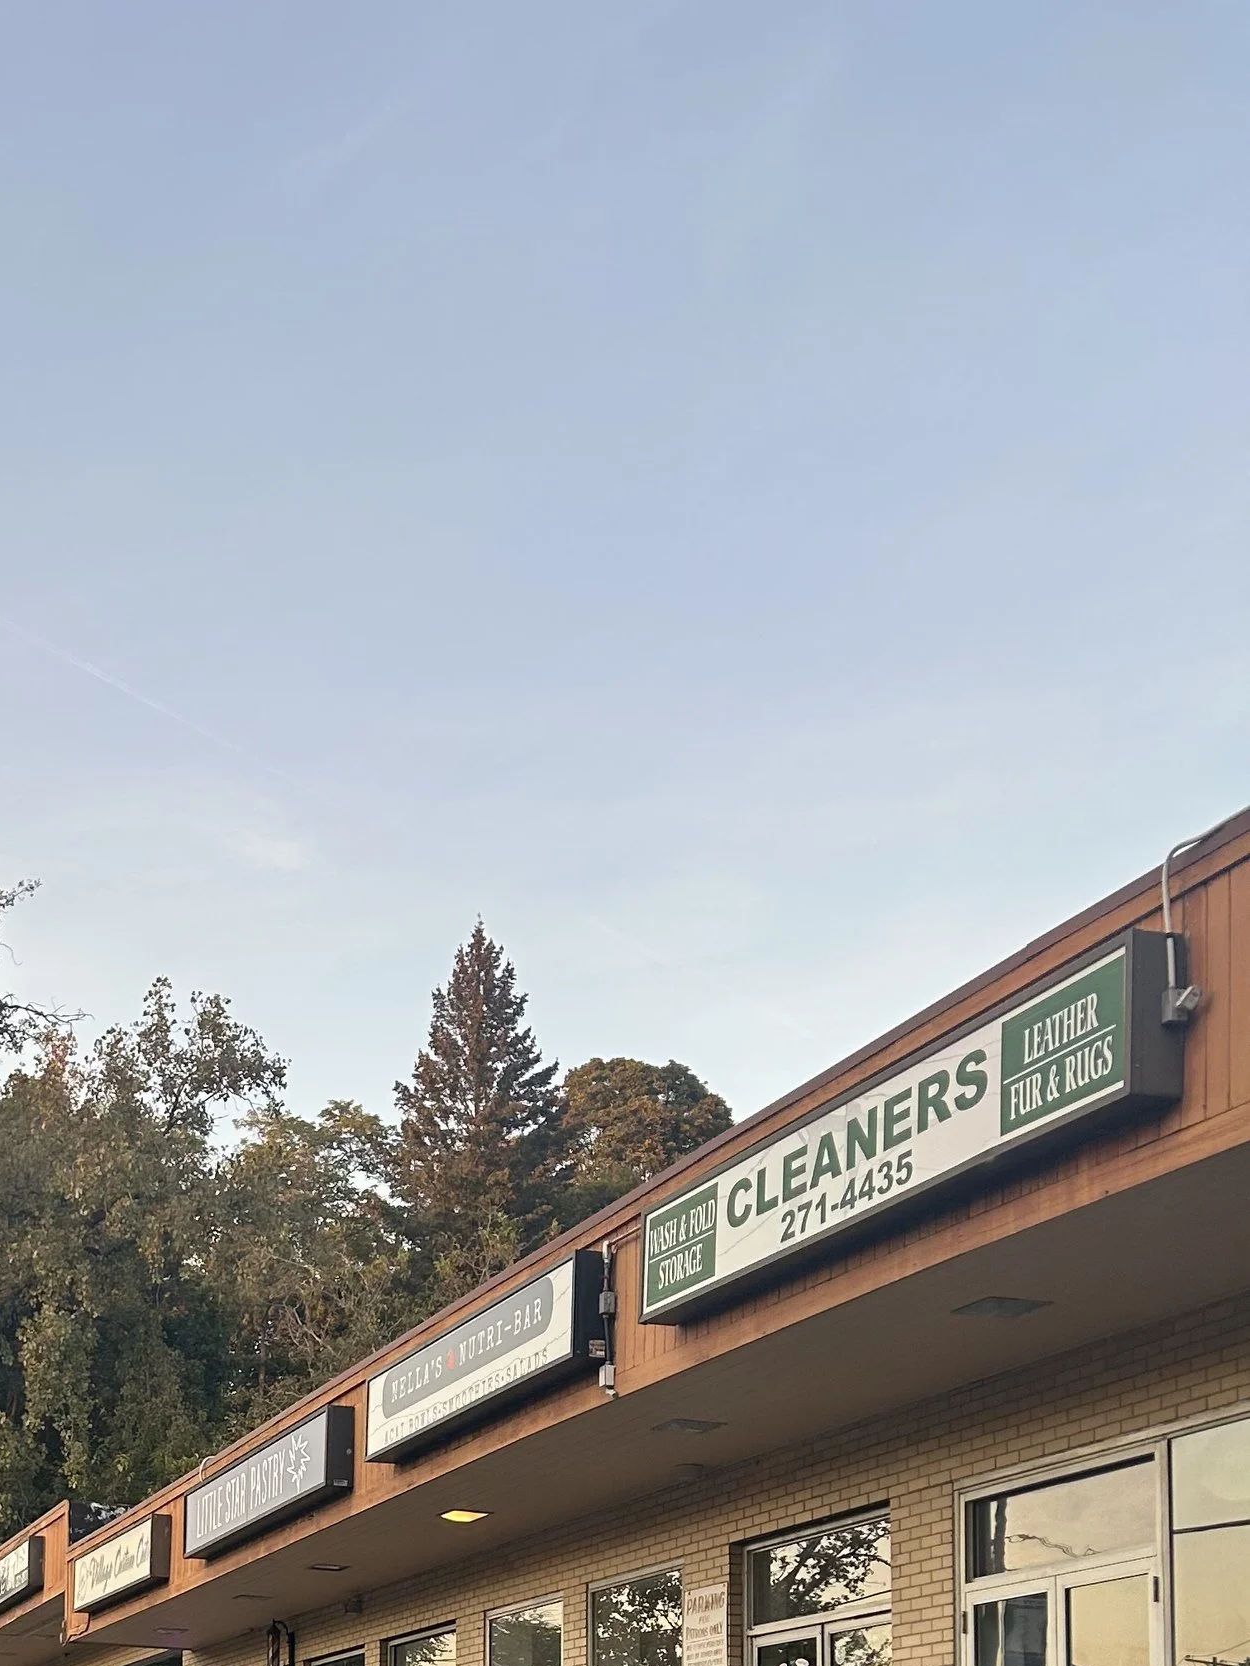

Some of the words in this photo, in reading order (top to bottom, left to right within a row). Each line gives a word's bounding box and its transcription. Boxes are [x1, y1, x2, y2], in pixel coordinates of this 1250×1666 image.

[1023, 993, 1098, 1064] LEATHER
[1010, 1072, 1042, 1120] FUR
[1047, 1065, 1060, 1102] &
[1065, 1035, 1113, 1093] RUGS
[727, 1049, 988, 1228] CLEANERS
[650, 1218, 678, 1257] WASH
[679, 1214, 687, 1242] &
[690, 1199, 715, 1237] FOLD
[780, 1149, 913, 1243] 271-4435
[658, 1243, 703, 1290] STORAGE
[391, 1356, 443, 1402] NELLA'S
[458, 1298, 543, 1366] NUTRI-BAR
[196, 1486, 223, 1538] LITTLE
[225, 1472, 247, 1523] STAR
[250, 1448, 285, 1510] PASTRY
[686, 1592, 725, 1616] PARKING
[709, 1621, 723, 1636] ONLY
